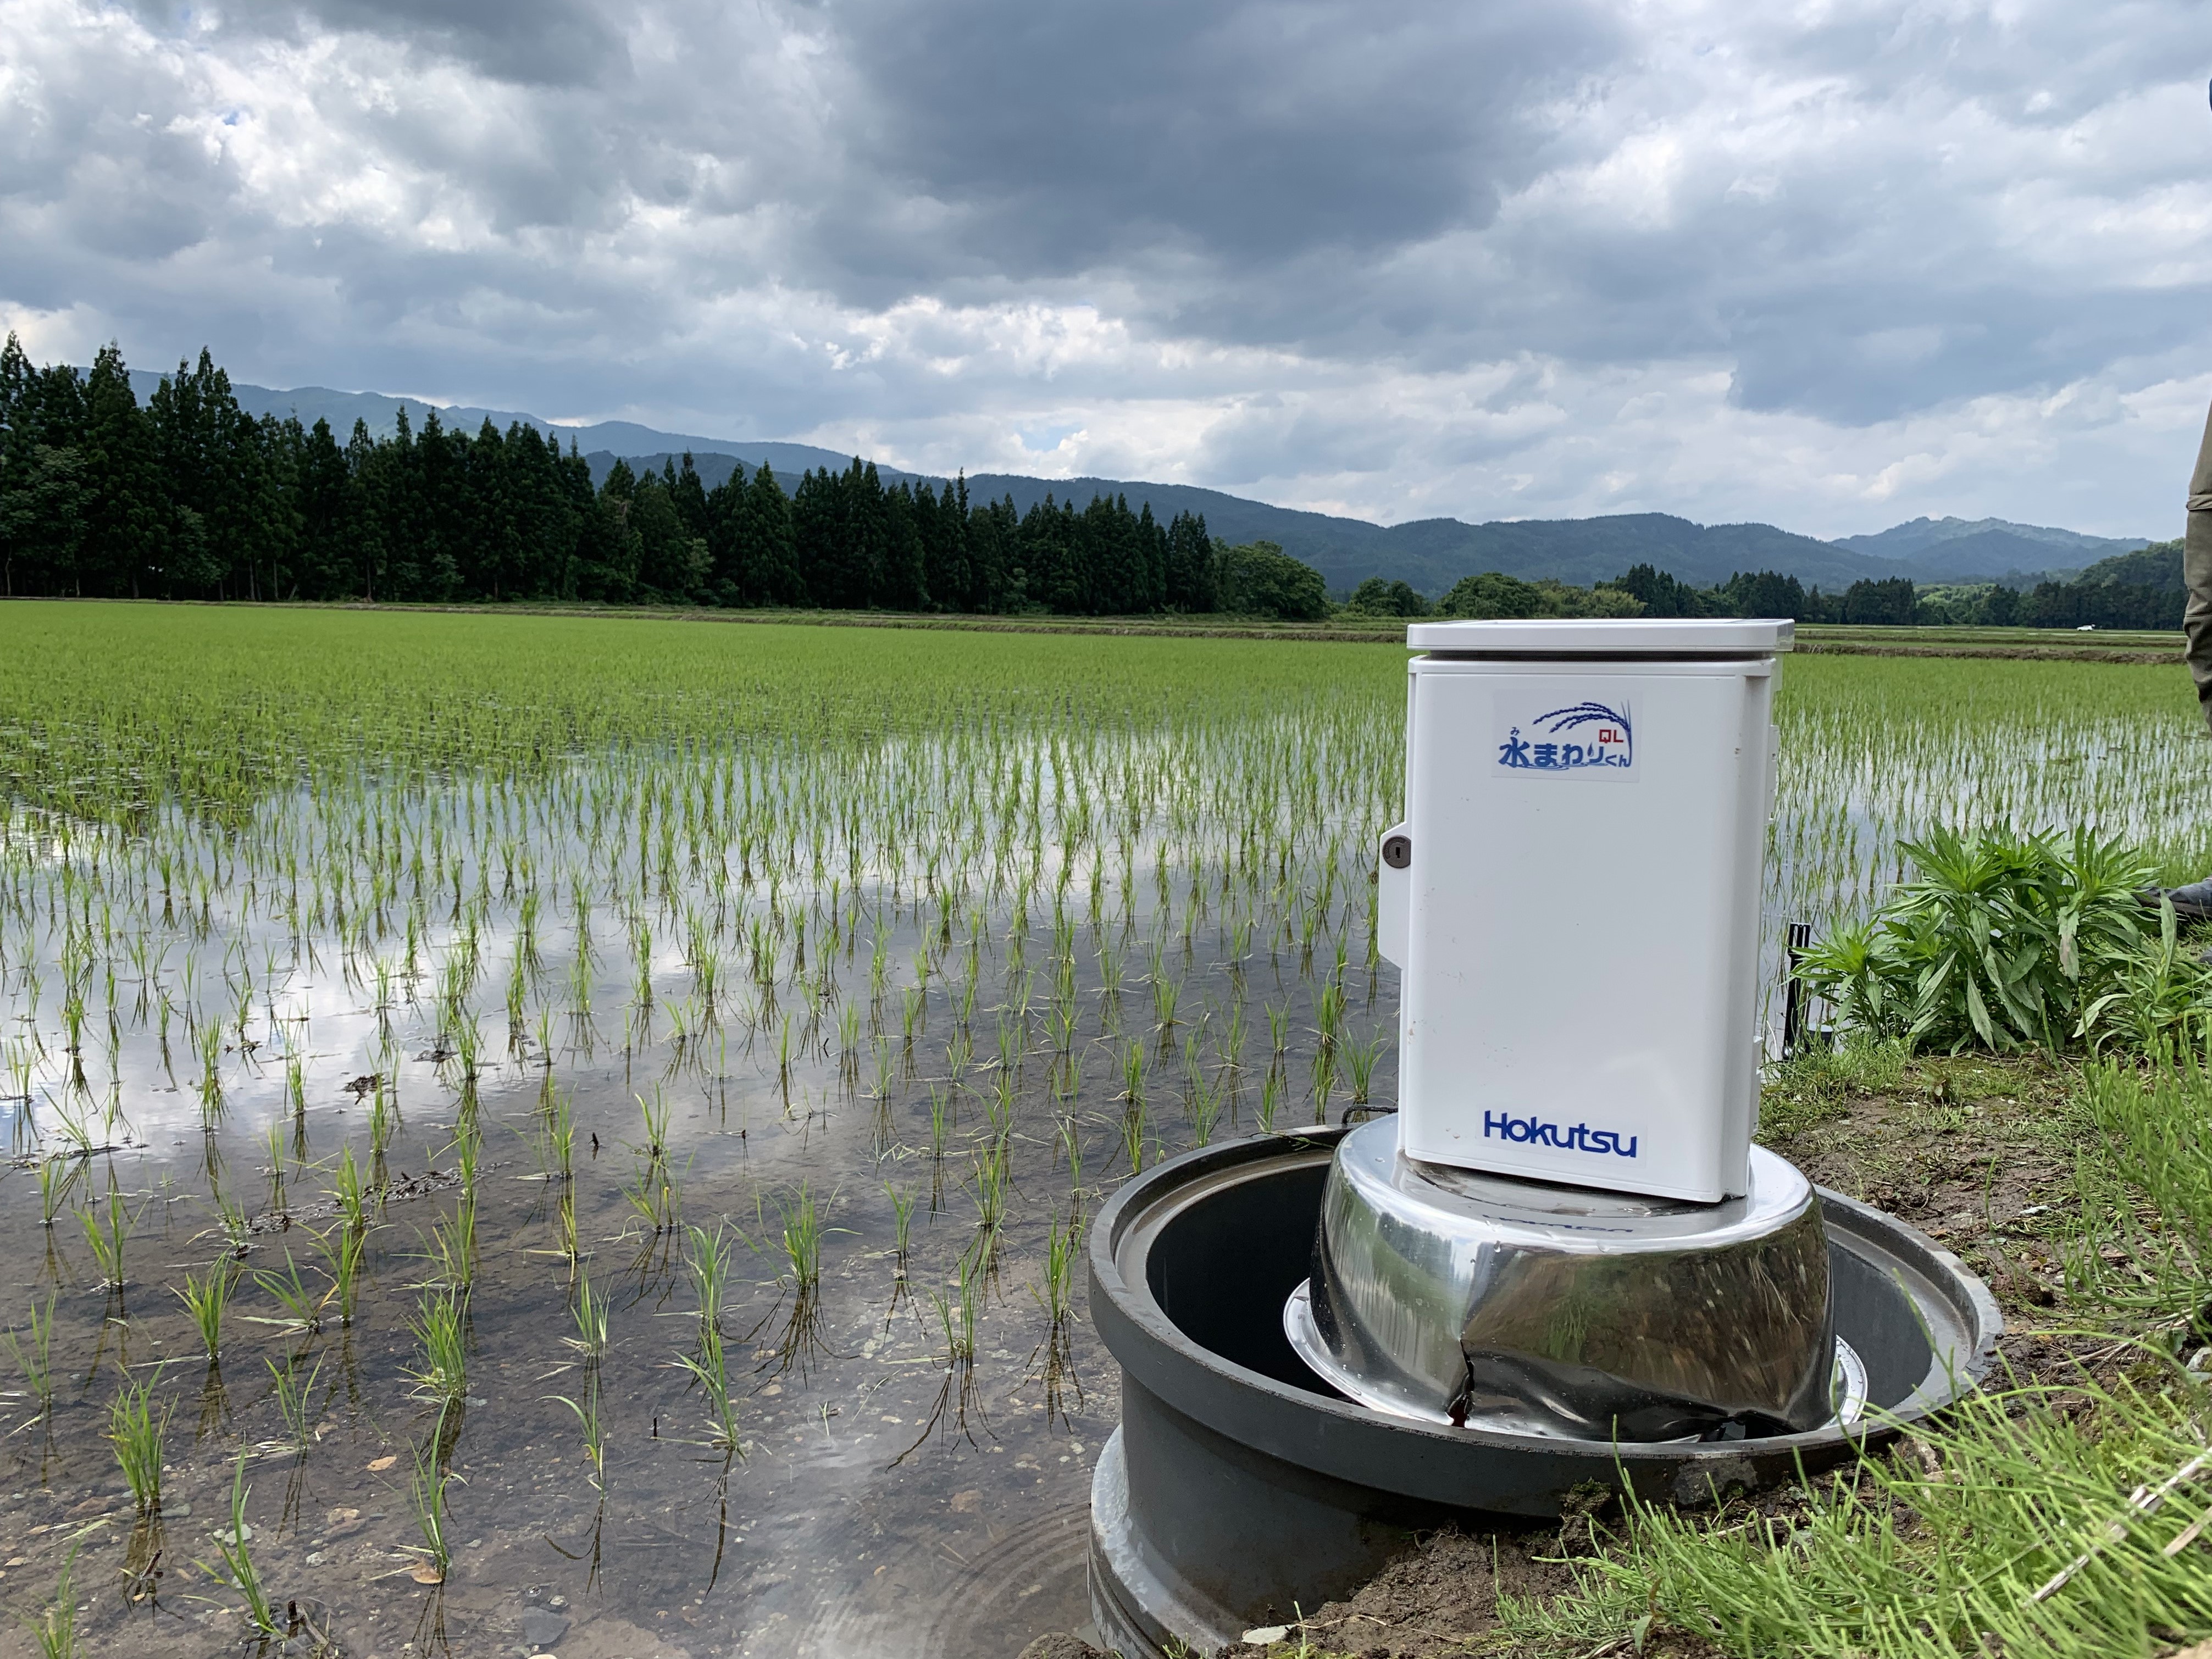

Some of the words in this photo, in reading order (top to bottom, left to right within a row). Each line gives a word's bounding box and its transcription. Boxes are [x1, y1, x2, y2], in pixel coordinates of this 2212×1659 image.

[1510, 727, 1520, 736] み
[1599, 729, 1624, 744] QL
[1498, 736, 1632, 768] 水まわりくん
[1484, 1110, 1637, 1158] Hokutsu
